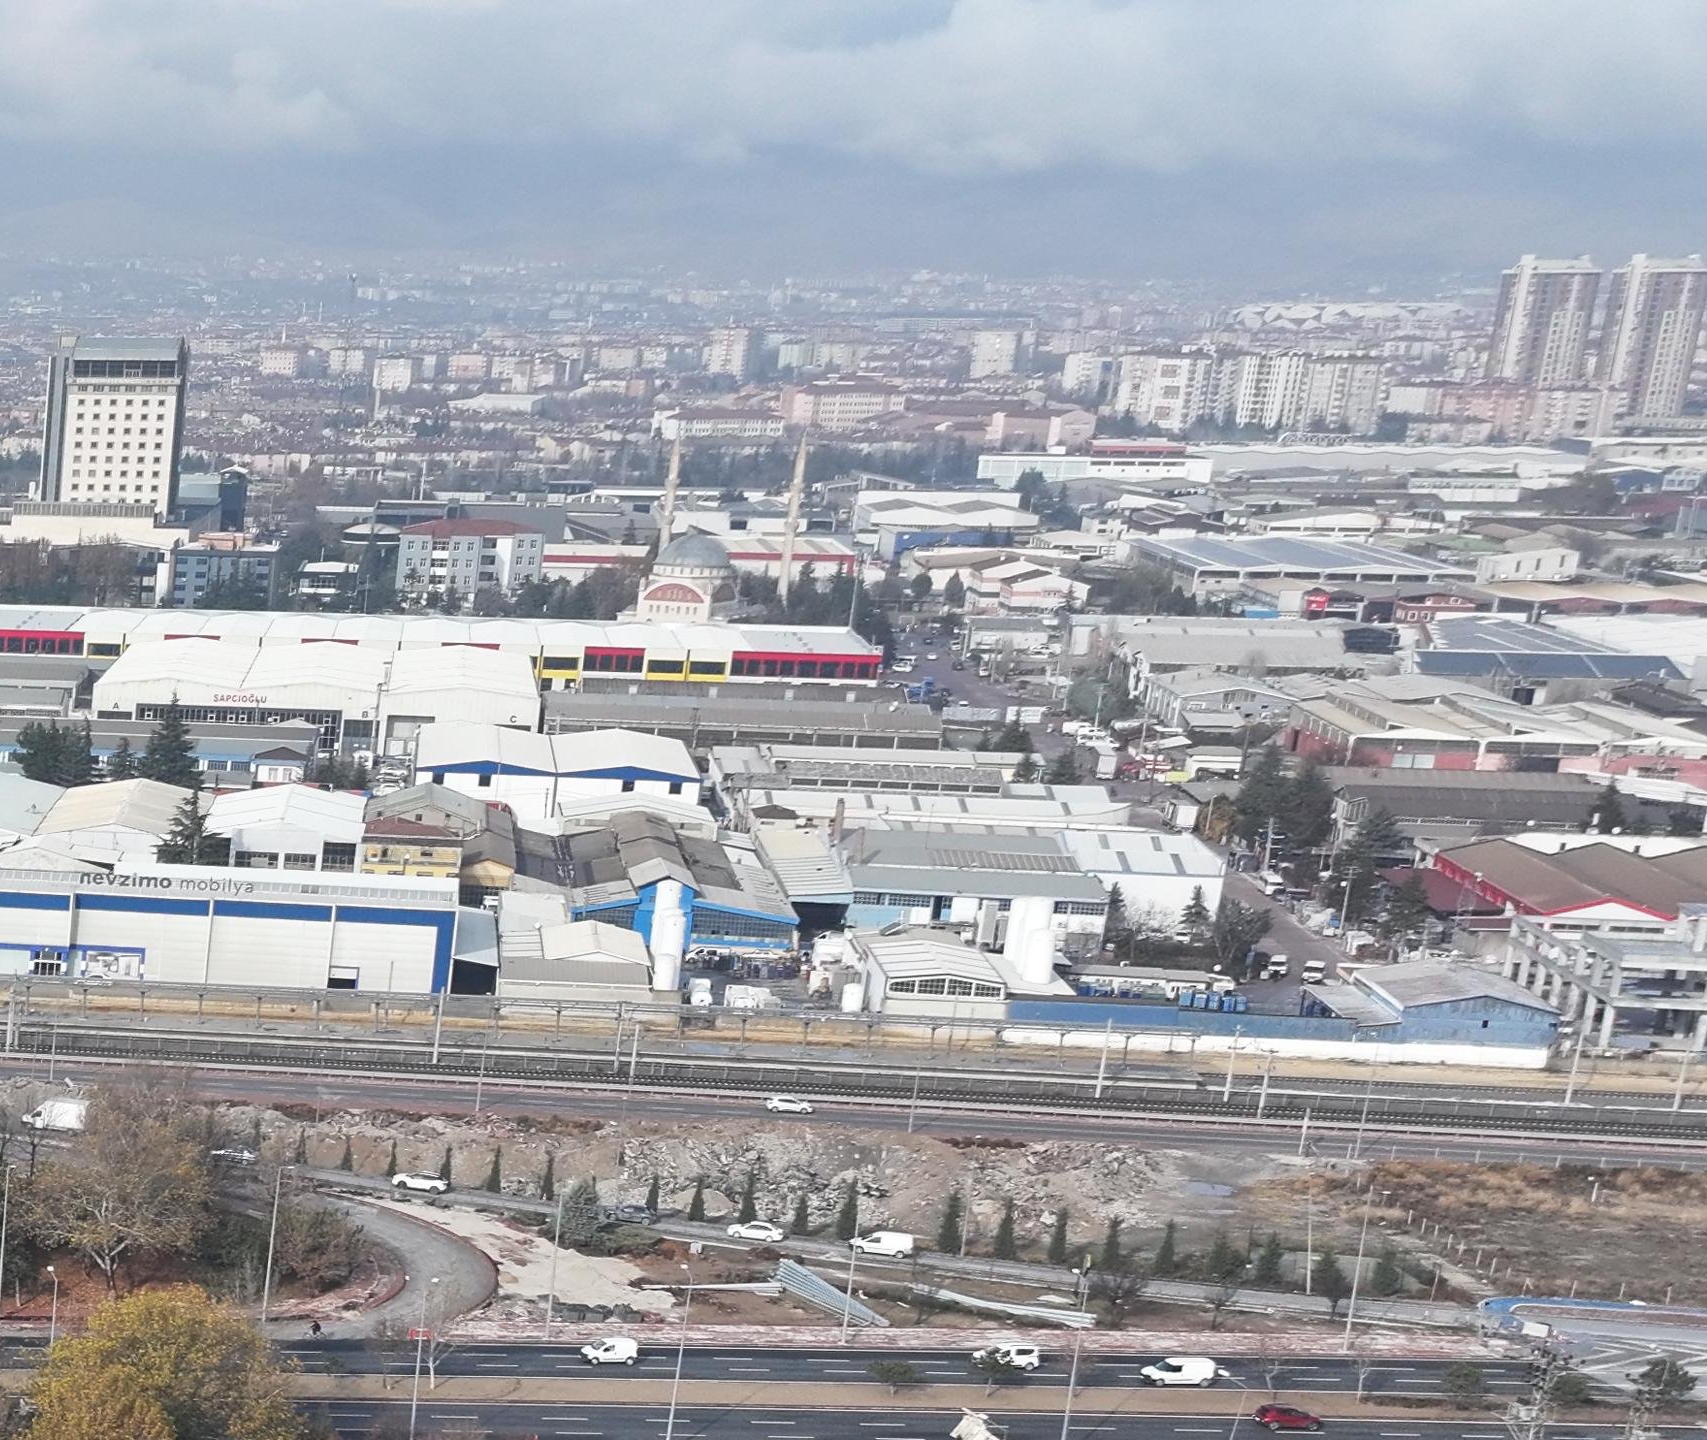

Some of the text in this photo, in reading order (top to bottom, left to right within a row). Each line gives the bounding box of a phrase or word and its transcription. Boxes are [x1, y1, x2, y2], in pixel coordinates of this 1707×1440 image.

[112, 702, 120, 710] A
[509, 714, 518, 724] C
[79, 871, 255, 896] nevzimo mobilya
